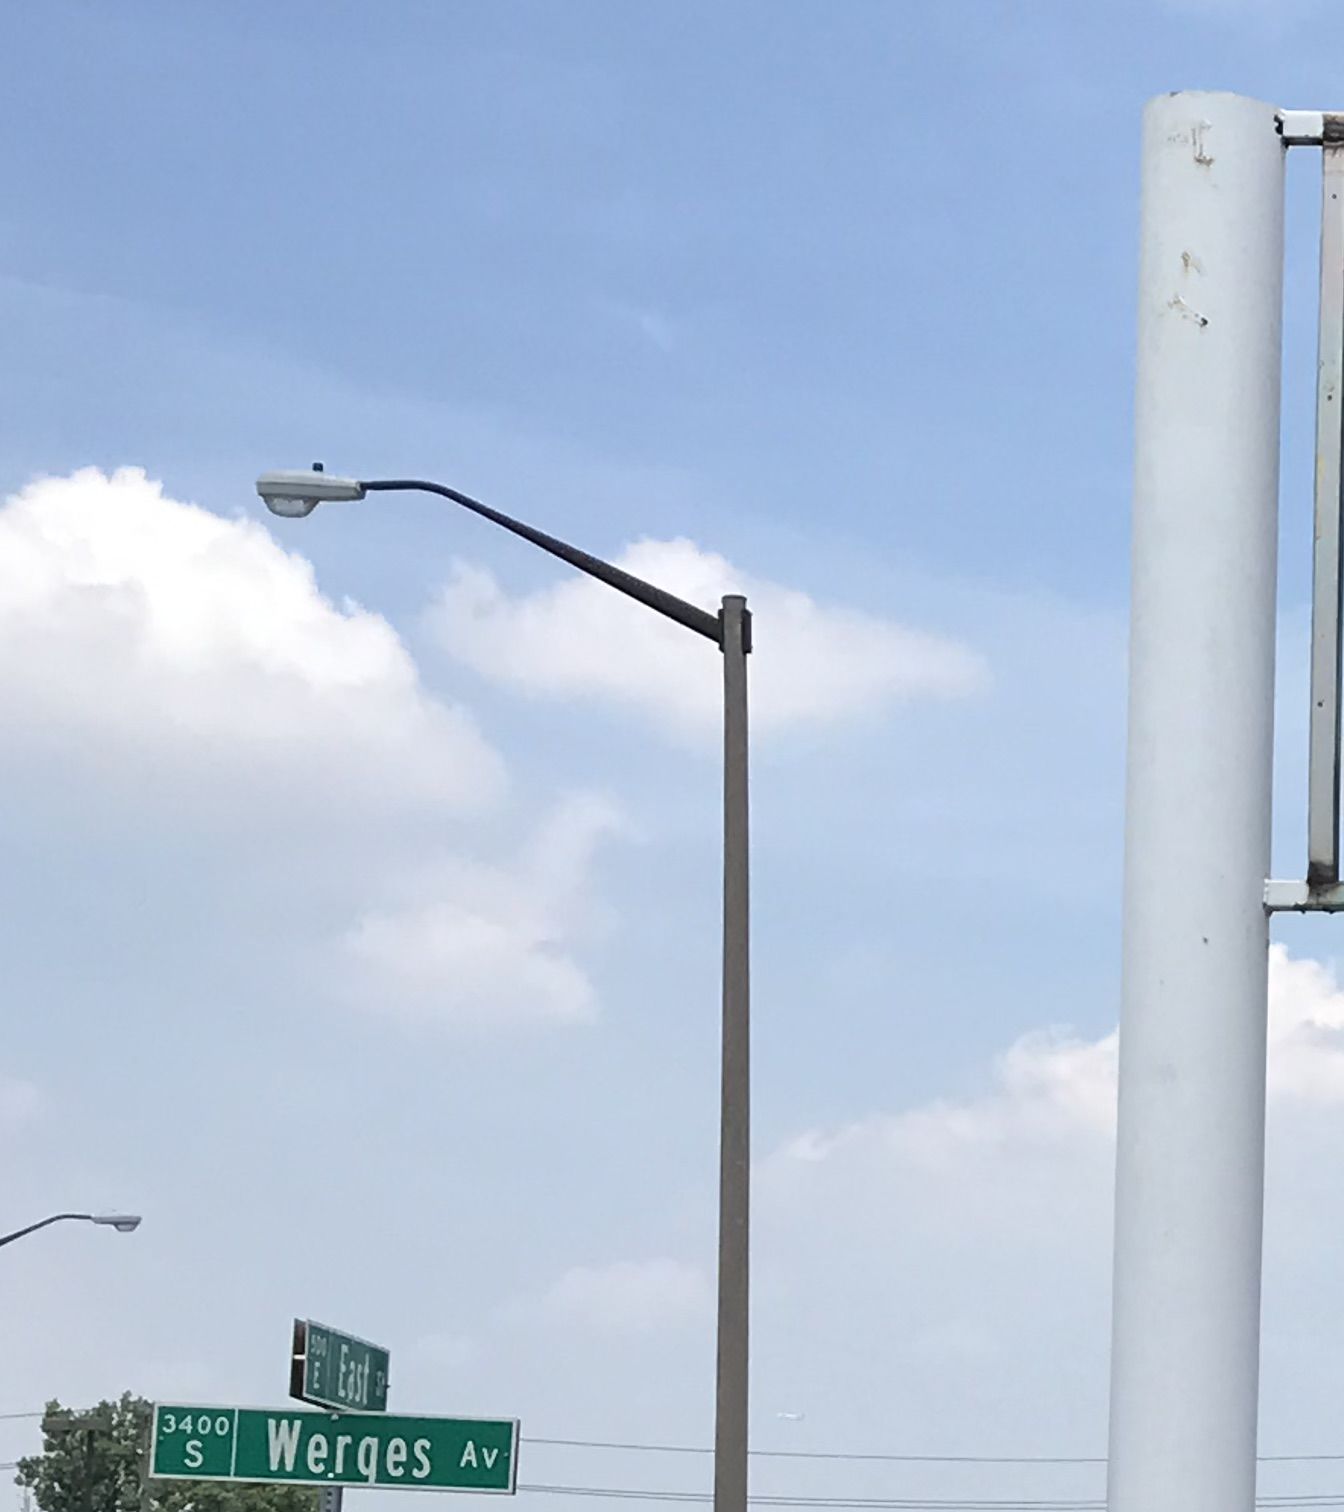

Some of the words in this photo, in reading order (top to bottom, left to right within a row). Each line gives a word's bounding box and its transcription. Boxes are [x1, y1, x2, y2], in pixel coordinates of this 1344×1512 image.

[338, 1343, 371, 1407] East
[162, 1414, 230, 1436] 3400
[184, 1440, 204, 1468] S
[267, 1418, 431, 1485] Werges
[460, 1441, 499, 1469] Av
